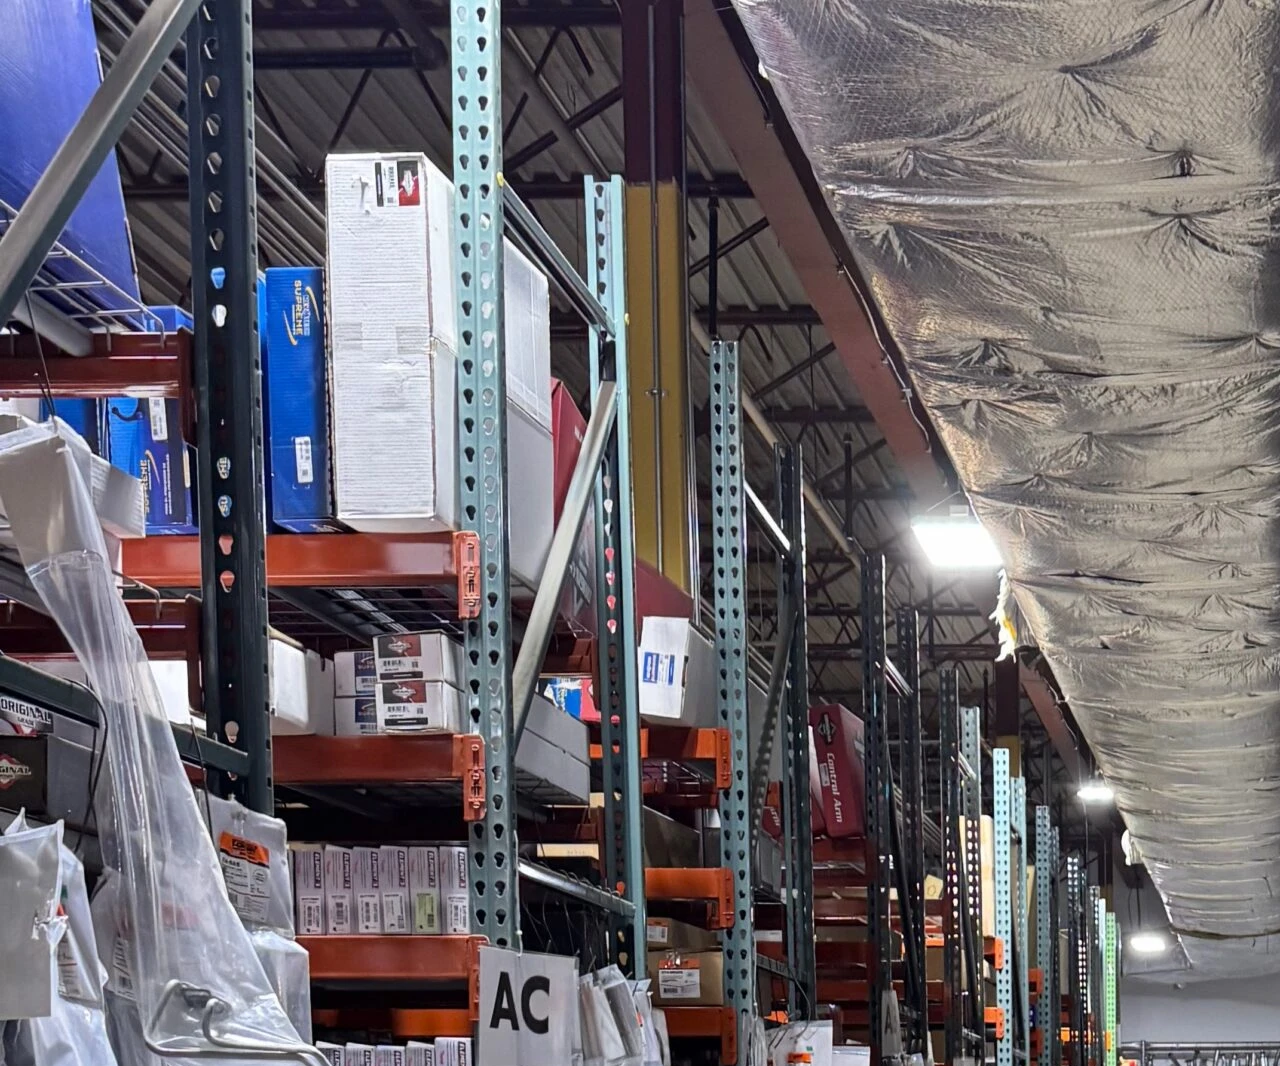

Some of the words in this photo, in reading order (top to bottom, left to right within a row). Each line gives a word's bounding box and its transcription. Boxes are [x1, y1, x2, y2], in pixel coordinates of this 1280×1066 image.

[1, 698, 51, 723] ORIGINAL
[0, 765, 31, 775] GINAL
[826, 752, 840, 796] Control
[833, 798, 843, 823] Arm
[489, 971, 551, 1035] AC
